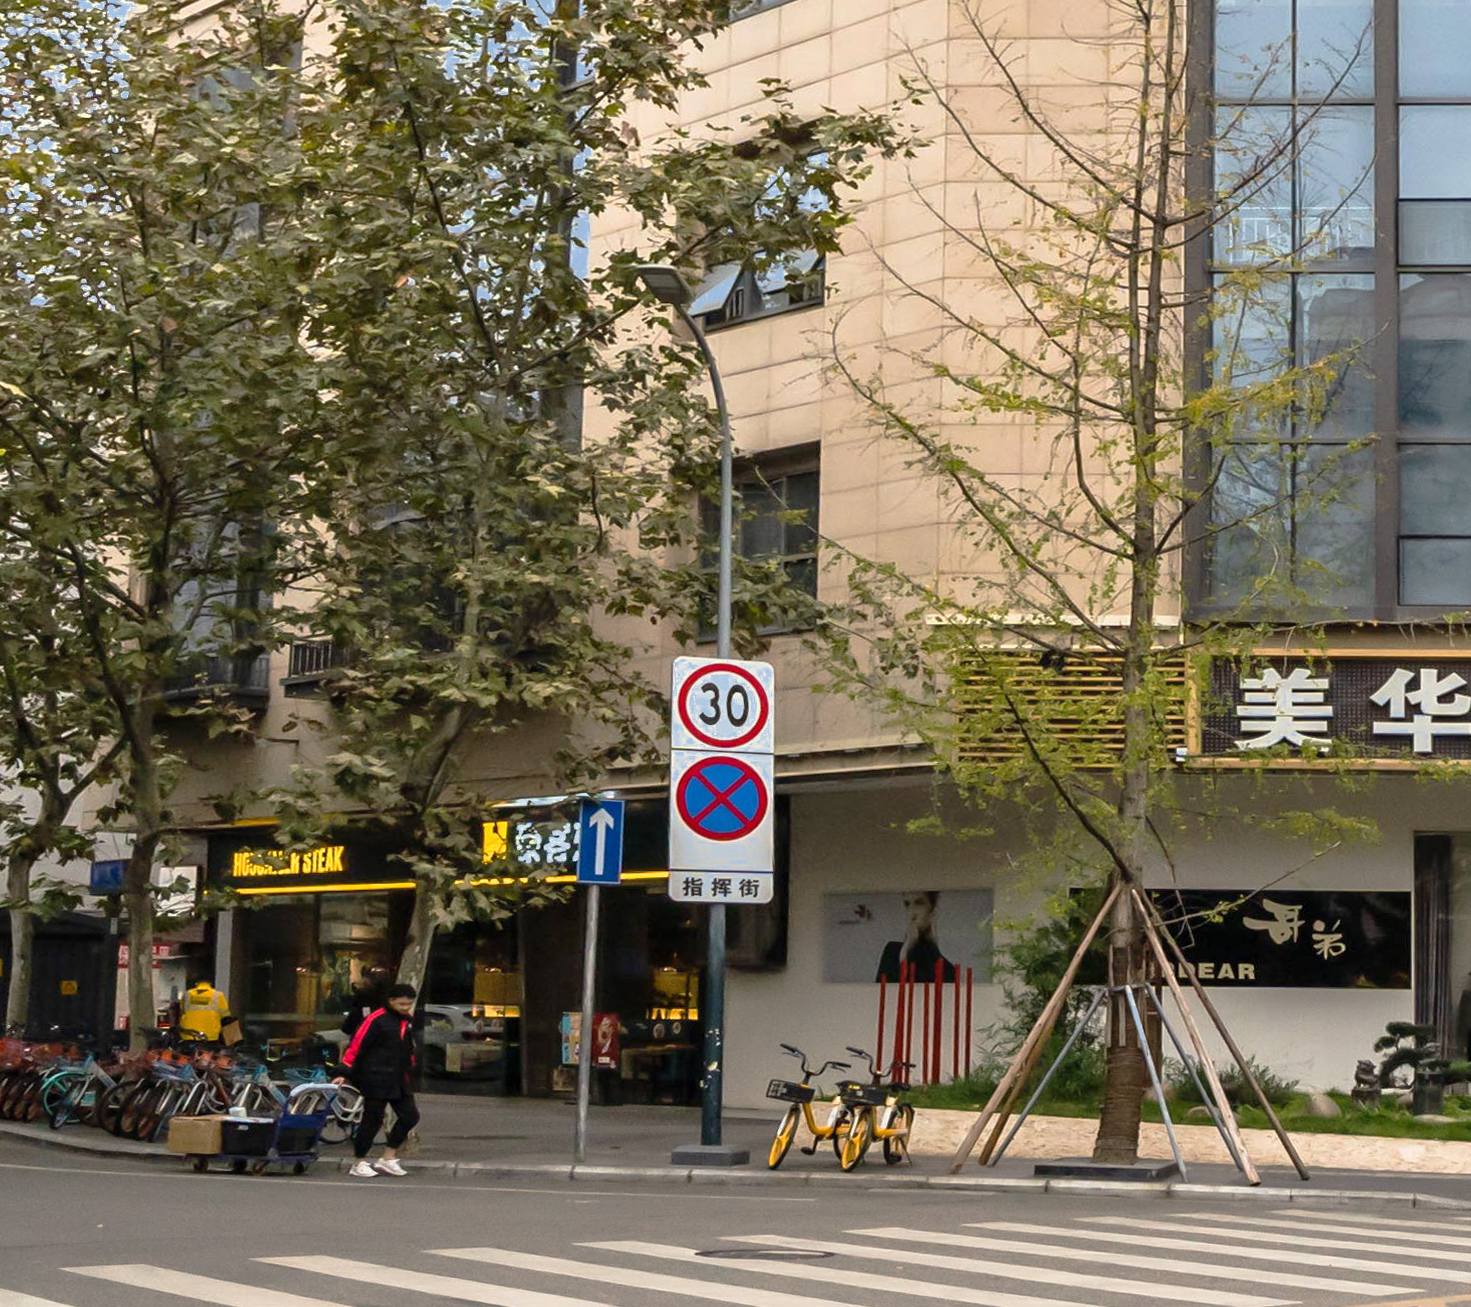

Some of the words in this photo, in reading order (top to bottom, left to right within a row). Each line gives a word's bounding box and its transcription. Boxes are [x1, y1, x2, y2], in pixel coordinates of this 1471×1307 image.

[698, 682, 750, 728] 30
[302, 845, 345, 873] STEAK
[682, 877, 760, 898] 指挥街
